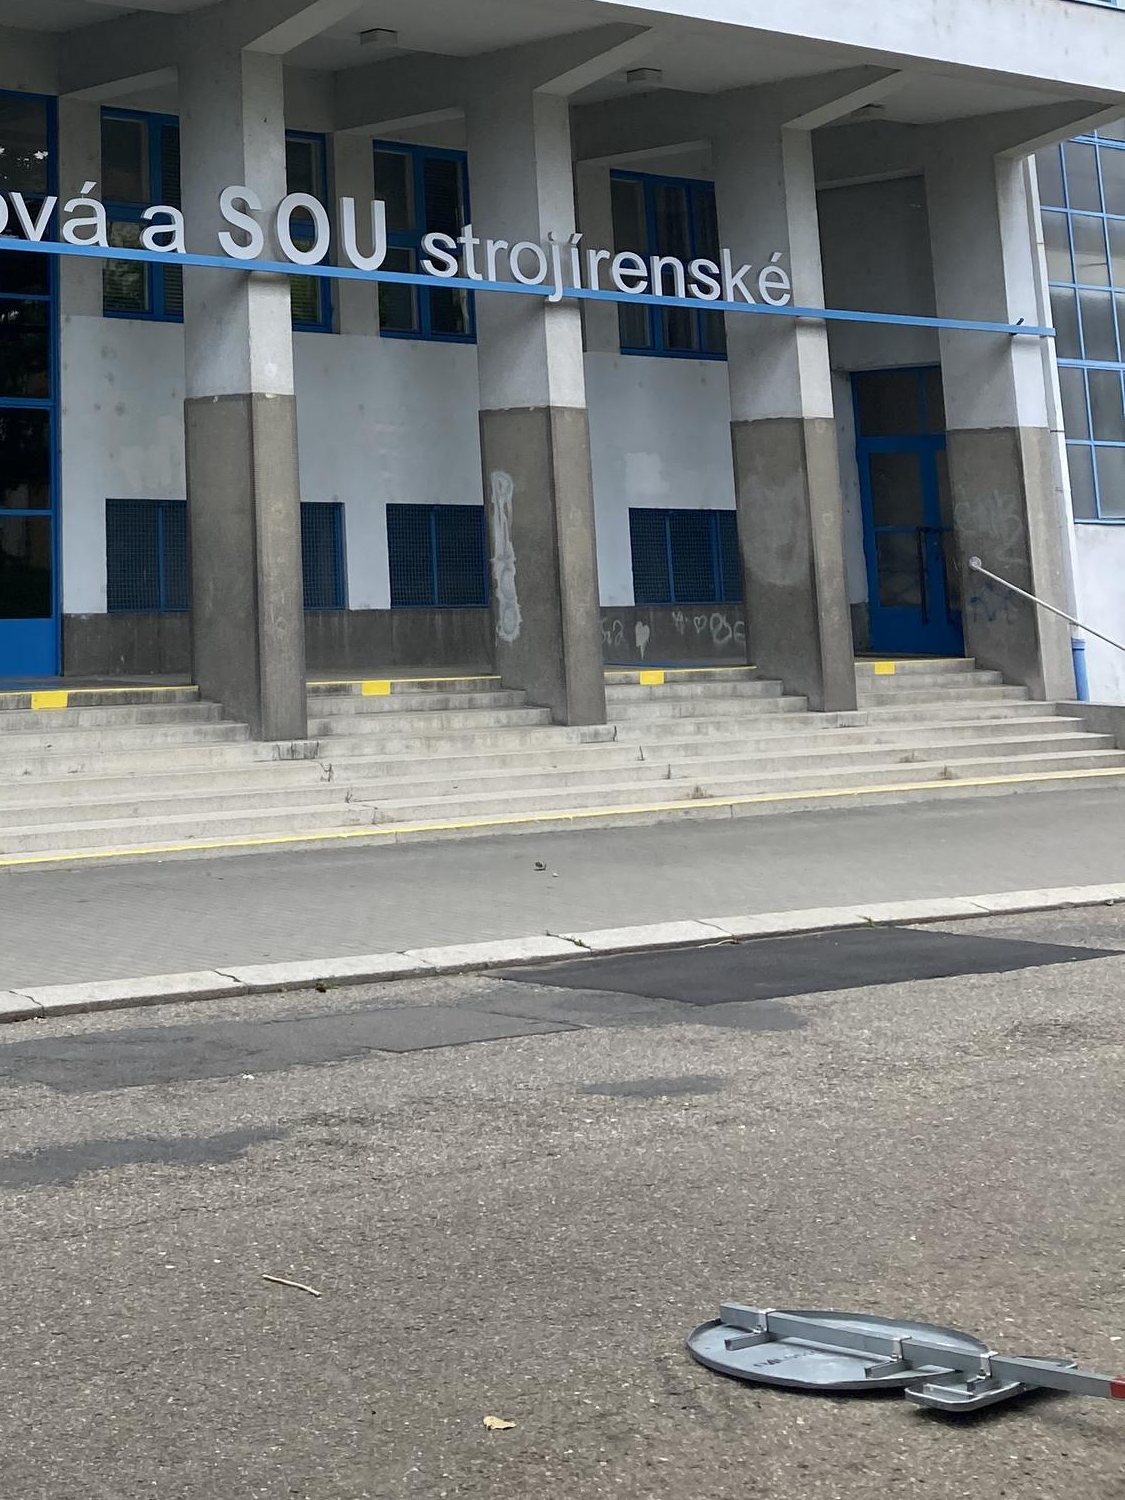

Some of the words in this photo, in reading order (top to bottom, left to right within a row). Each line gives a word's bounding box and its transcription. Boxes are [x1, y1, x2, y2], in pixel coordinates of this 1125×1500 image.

[140, 203, 186, 255] a
[218, 185, 387, 272] SOU
[420, 223, 793, 307] strojírenské
